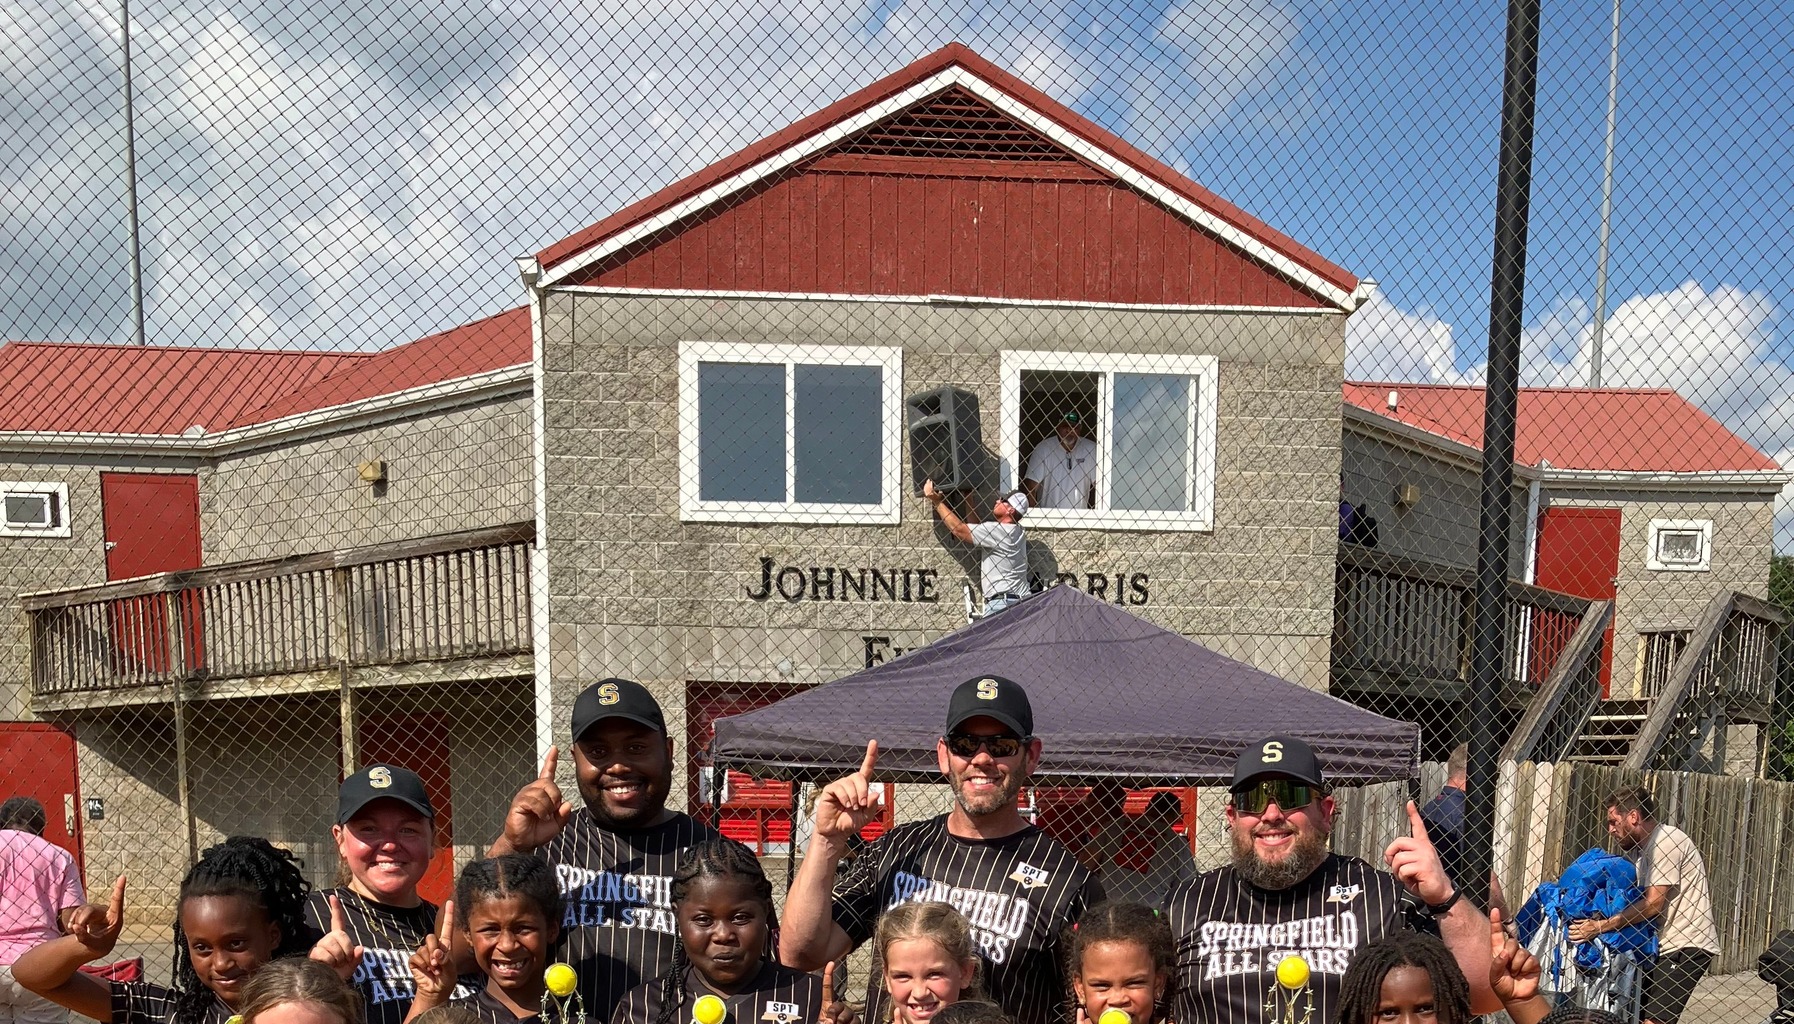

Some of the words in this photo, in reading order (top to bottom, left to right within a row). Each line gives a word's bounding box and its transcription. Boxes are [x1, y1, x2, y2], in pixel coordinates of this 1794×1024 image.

[747, 556, 939, 603] JOHNNIE
[598, 683, 620, 706] S
[976, 678, 998, 700] S
[1261, 741, 1284, 763] S
[368, 766, 392, 789] S
[1021, 865, 1043, 880] SPT
[556, 863, 674, 910] SPRINGFI
[562, 901, 614, 928] ALL
[619, 906, 676, 935] STA
[1198, 910, 1359, 958] SPRINGFIELD
[1204, 951, 1260, 981] ALL
[1266, 949, 1350, 975] SARS
[772, 1002, 794, 1014] SPT
